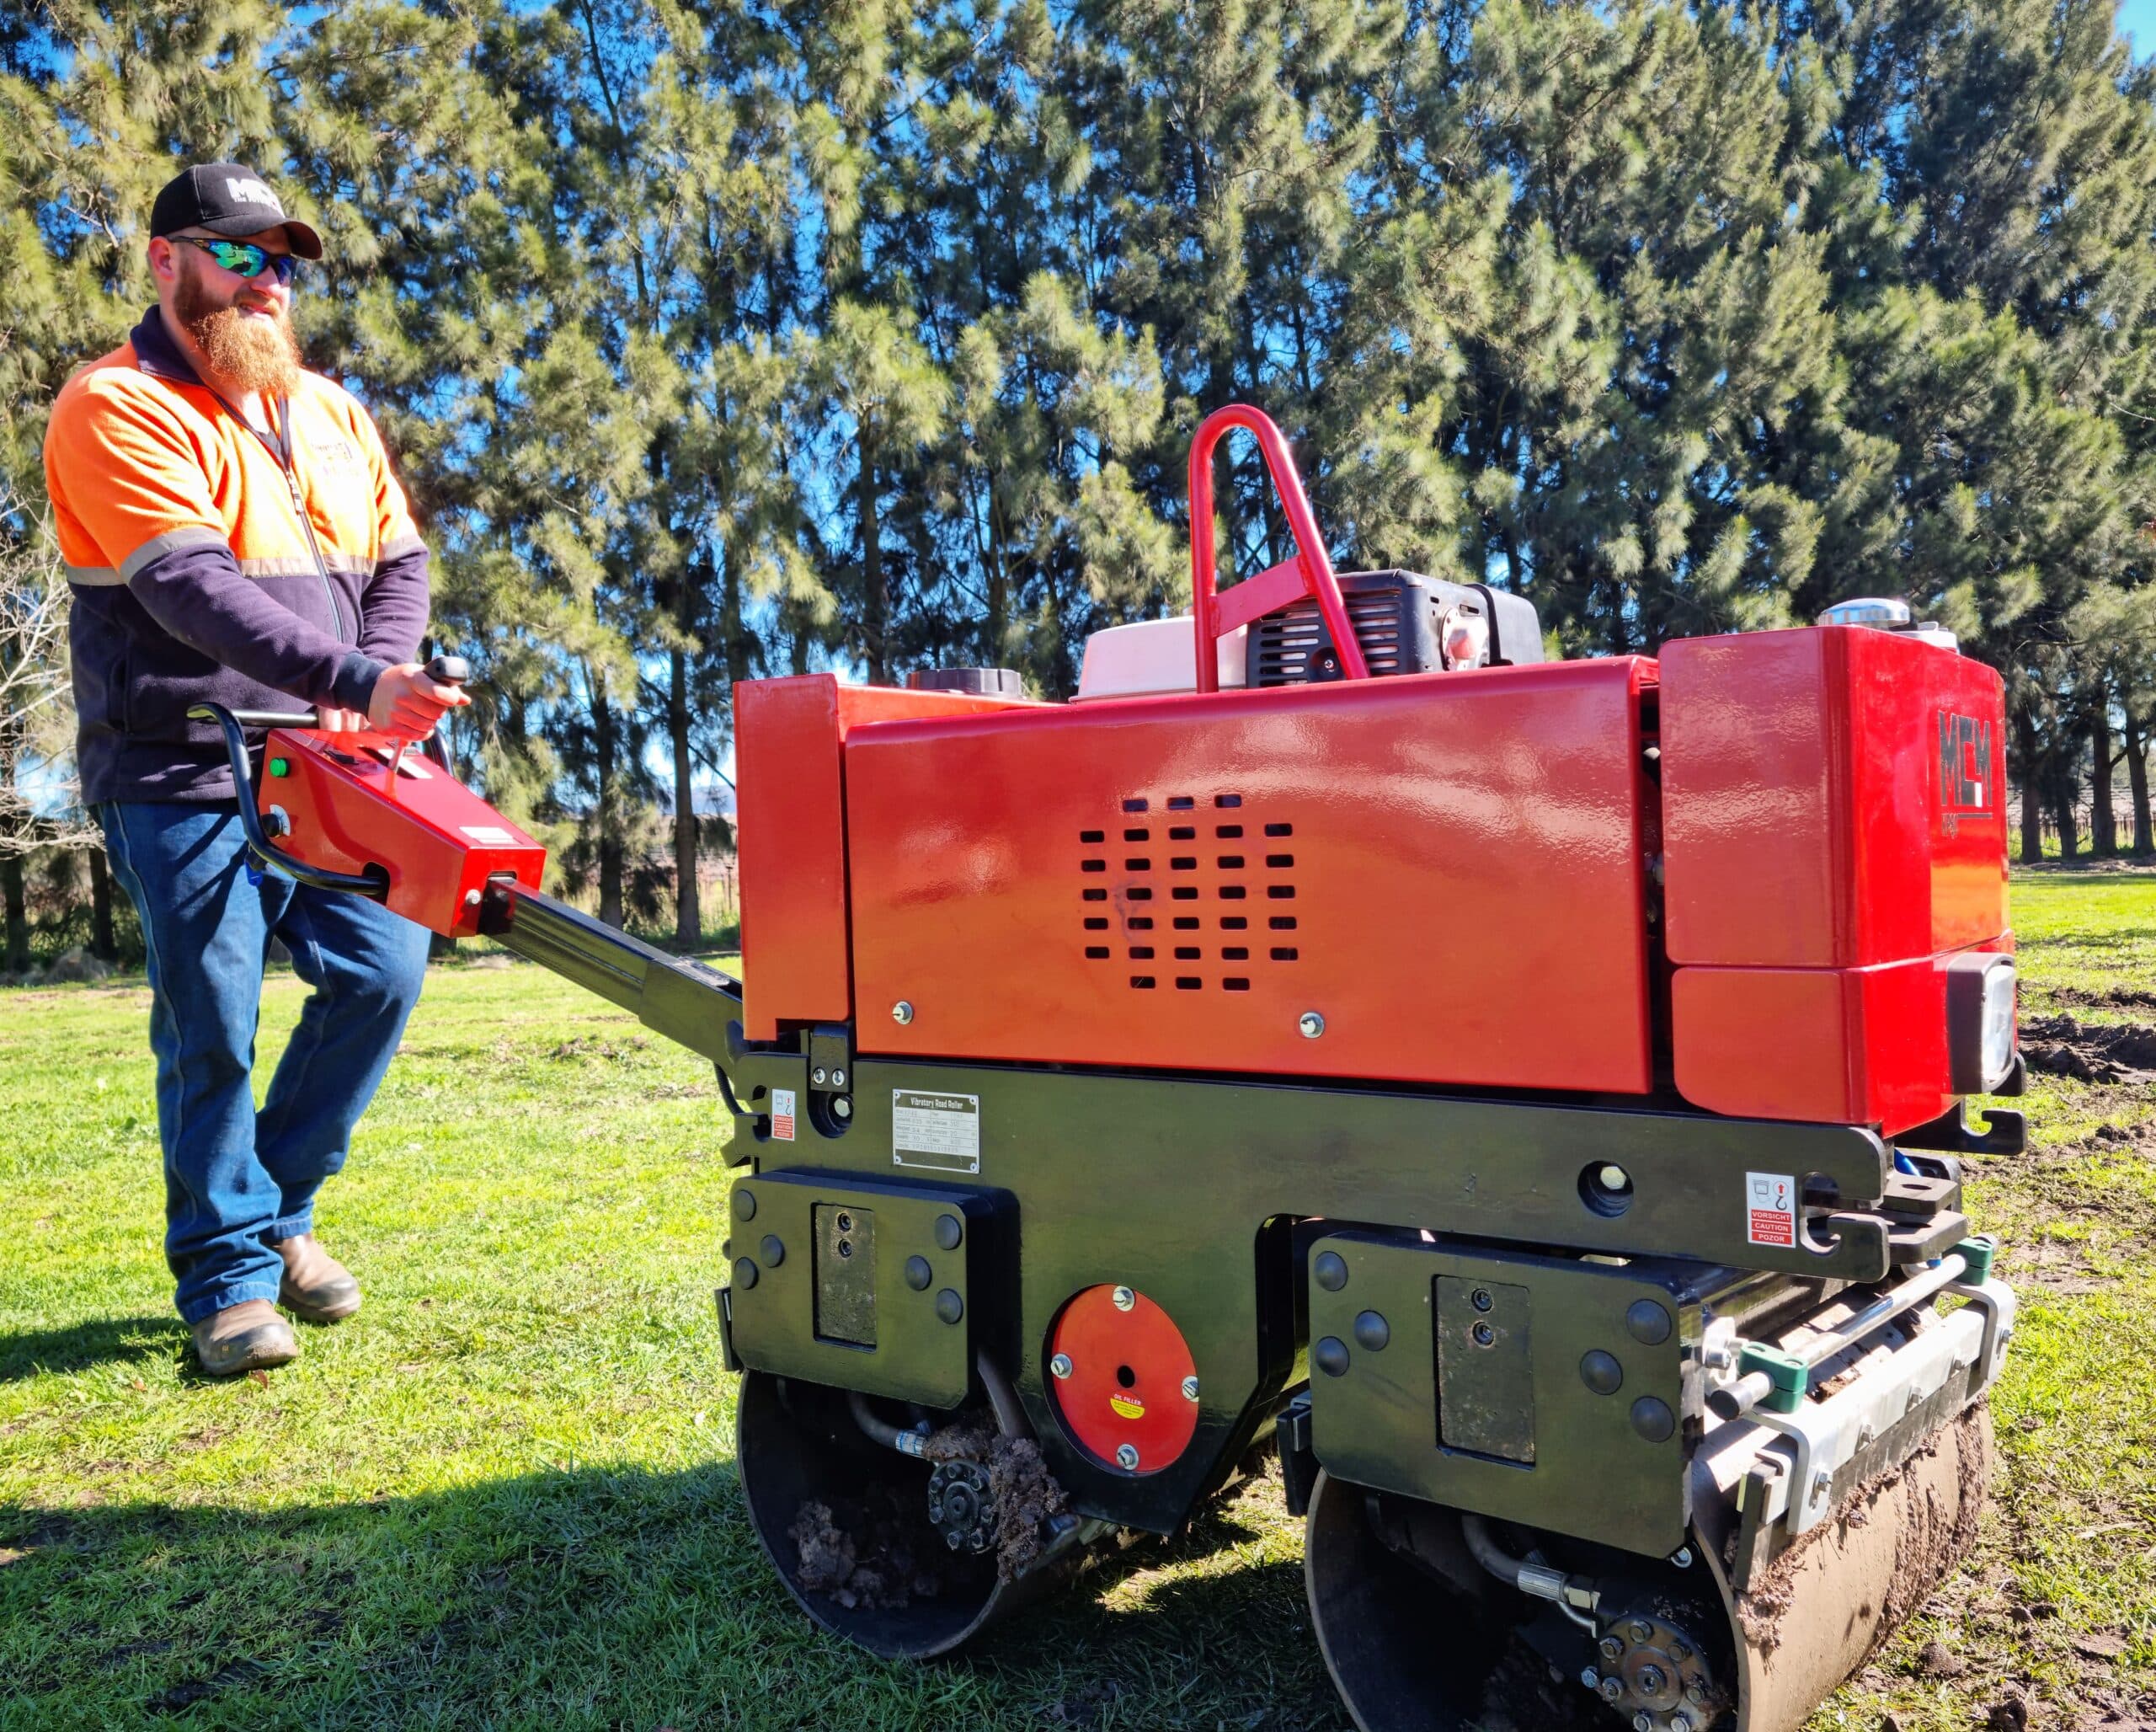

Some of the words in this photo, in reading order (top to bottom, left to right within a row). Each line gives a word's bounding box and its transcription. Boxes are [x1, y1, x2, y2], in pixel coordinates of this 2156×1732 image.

[911, 1097, 933, 1109] Vibratory
[935, 1099, 947, 1108] Road
[948, 1100, 963, 1109] Roller
[1752, 1211, 1790, 1221] VORSICHT
[1755, 1221, 1788, 1232] CAUTION
[1758, 1233, 1785, 1243] POZOR
[1123, 1396, 1141, 1405] FILLER
